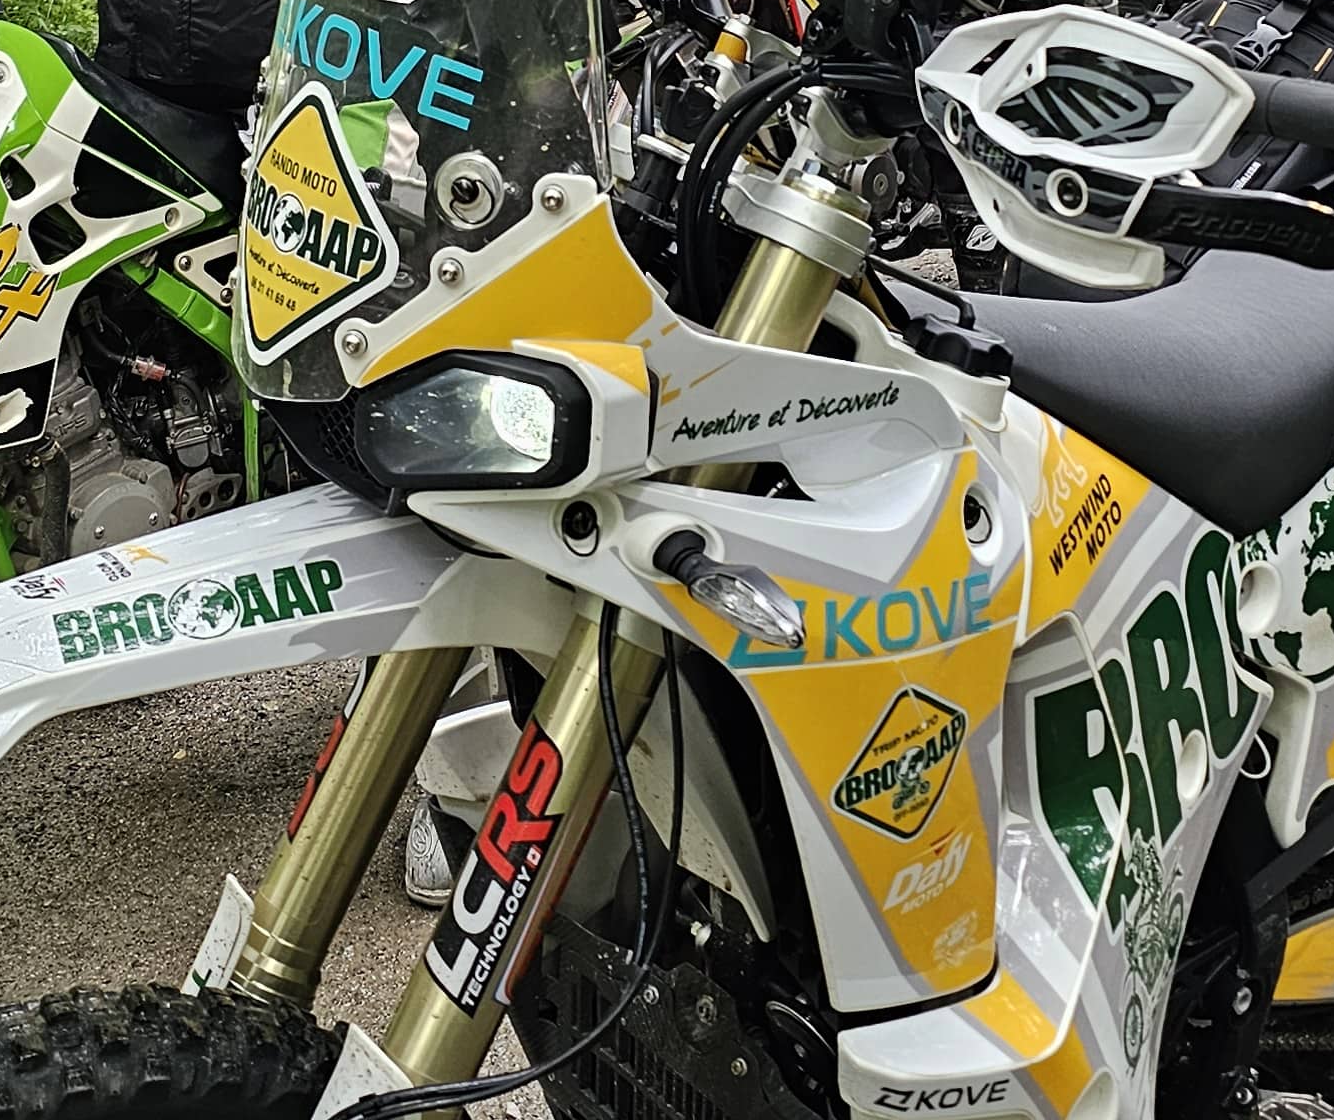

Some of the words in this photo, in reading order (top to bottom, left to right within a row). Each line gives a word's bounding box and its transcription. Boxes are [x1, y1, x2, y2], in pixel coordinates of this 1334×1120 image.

[270, 148, 300, 179] RANDO
[300, 168, 338, 198] MOTO
[671, 408, 760, 442] Aventure
[767, 400, 792, 428] et
[796, 381, 900, 424] Découverte
[1049, 474, 1112, 576] WESTWIND
[1085, 500, 1122, 565] MOTO
[824, 573, 992, 659] KOVE
[872, 737, 901, 757] TRIP
[425, 721, 560, 999] LCRS
[882, 831, 973, 912] Dafy
[461, 866, 531, 1007] TECHNOLOGY
[914, 1079, 1010, 1111] KOVE
